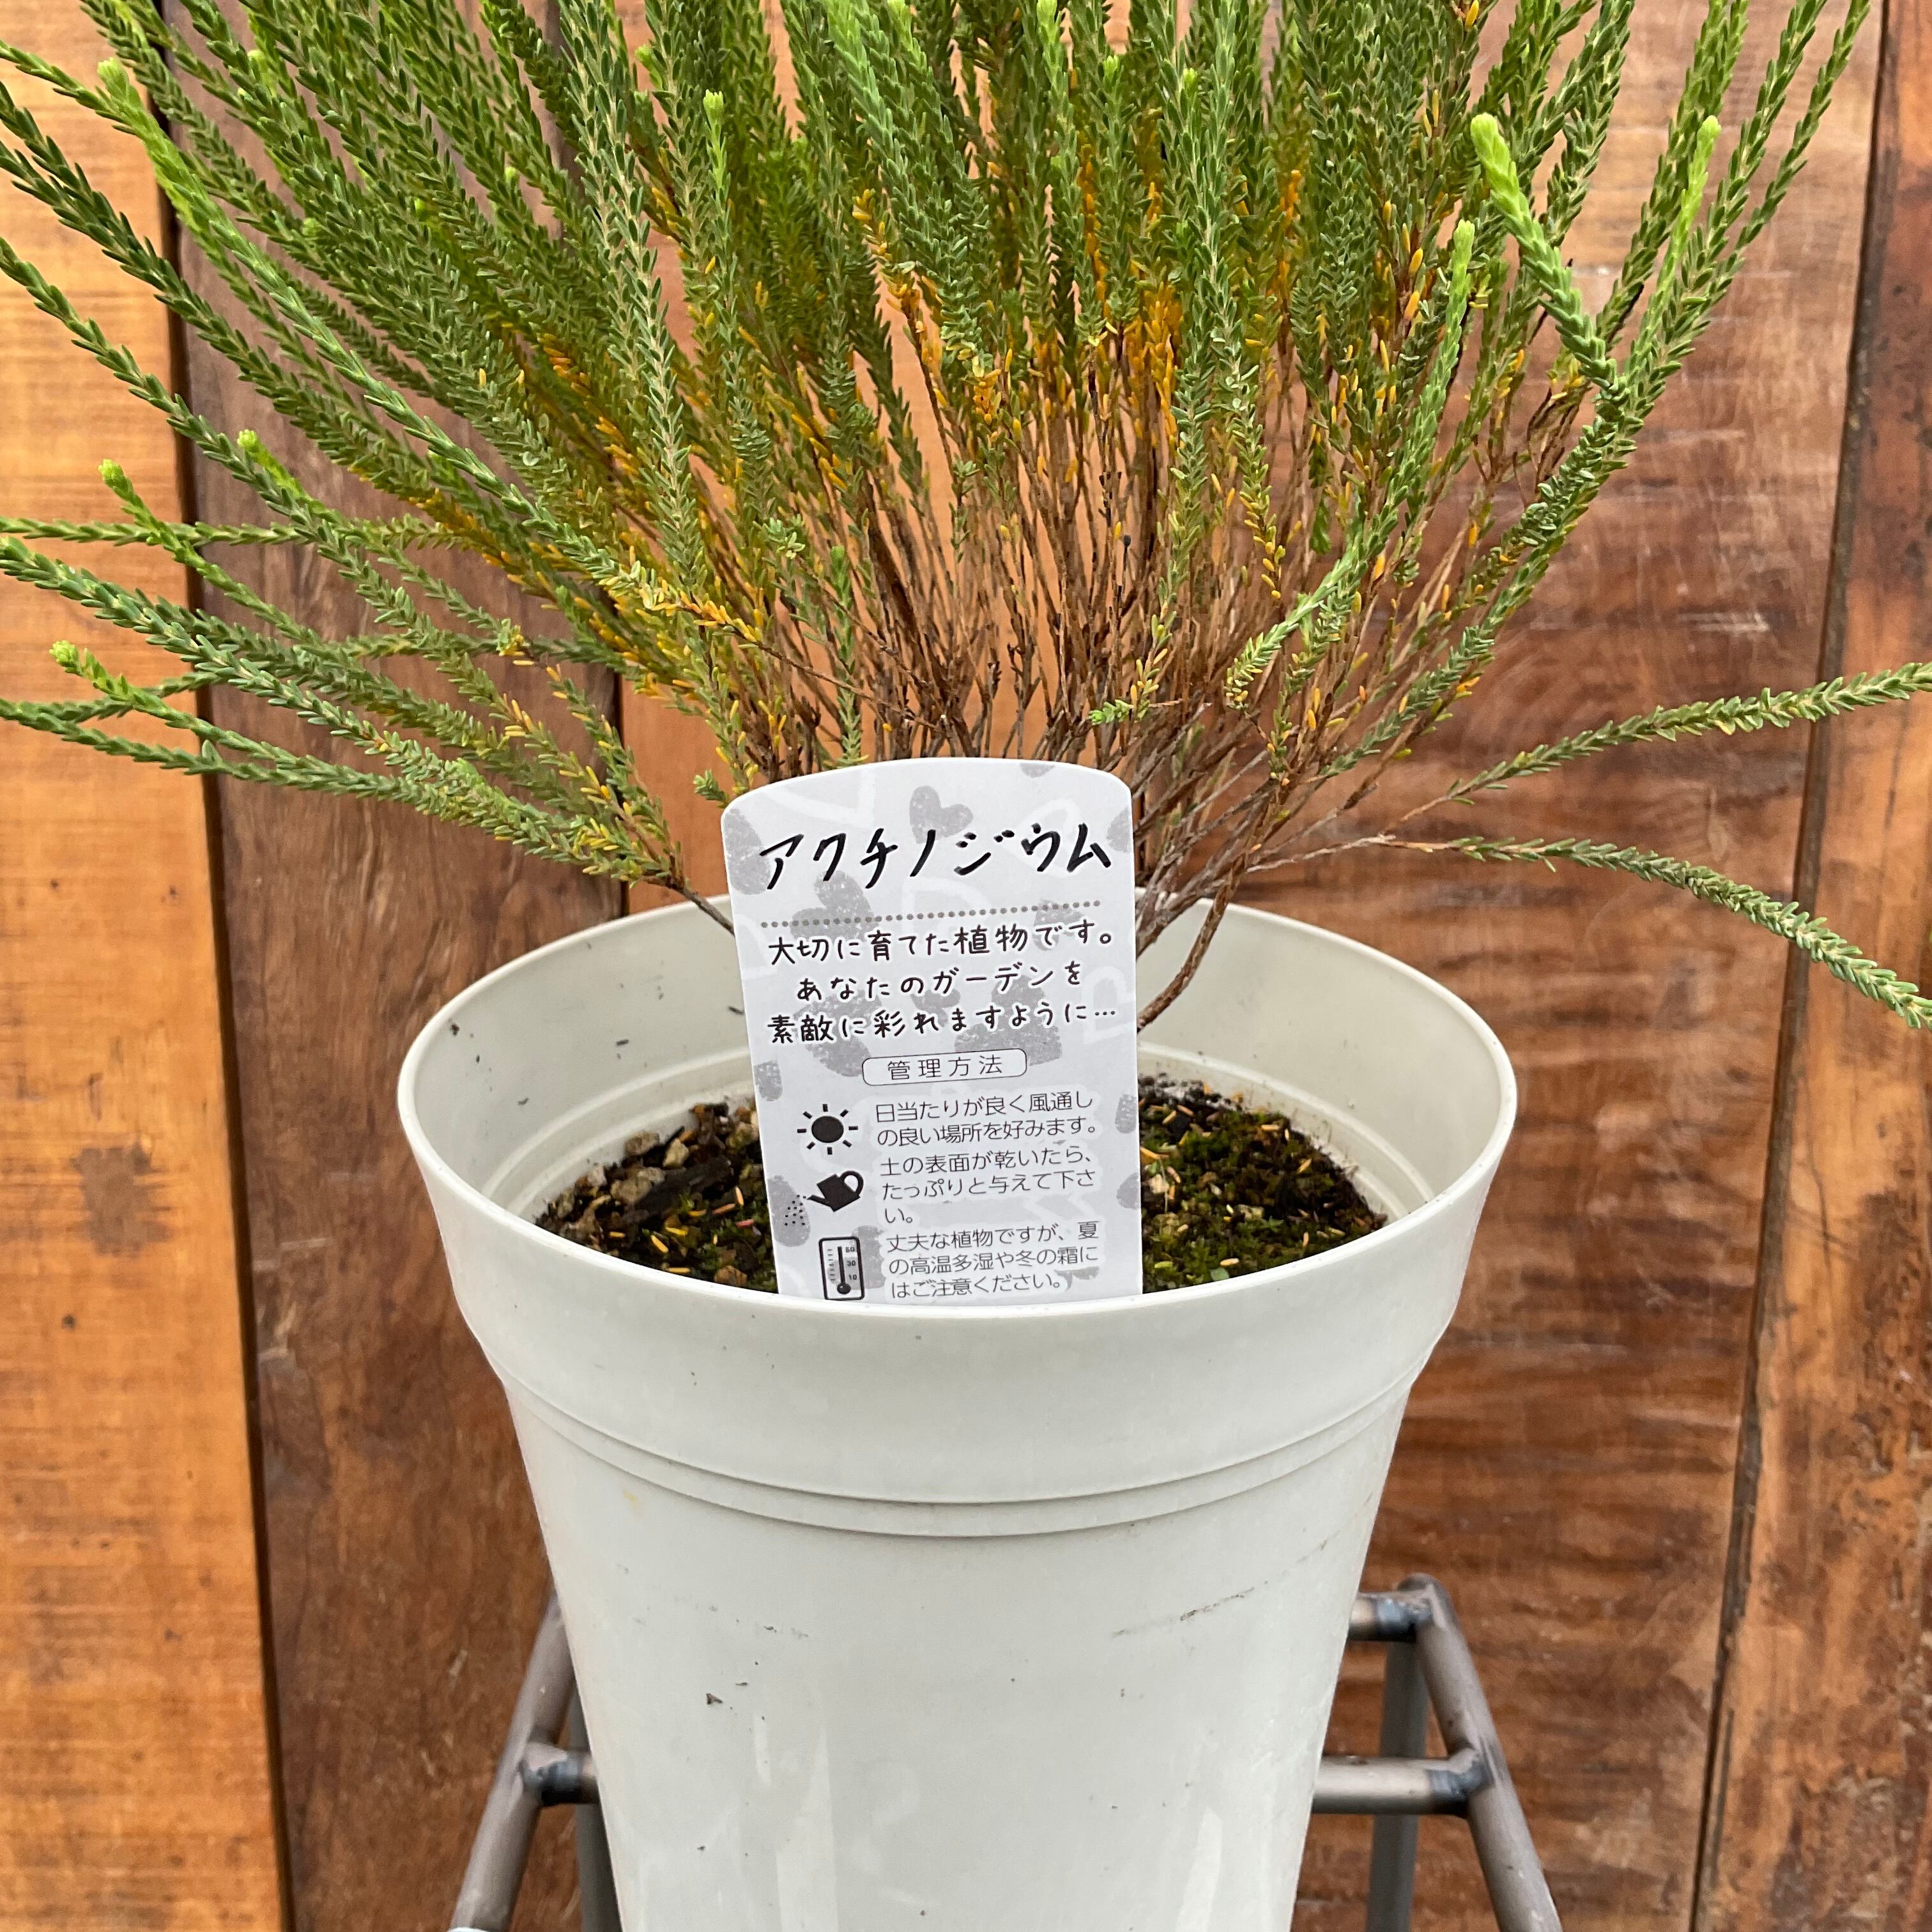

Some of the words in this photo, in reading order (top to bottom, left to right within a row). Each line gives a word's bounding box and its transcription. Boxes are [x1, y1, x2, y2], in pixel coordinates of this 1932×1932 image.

[759, 822, 1112, 889] アクチノジウム
[768, 919, 1112, 966] 大切に育てた植物です。
[797, 961, 1082, 1001] あなたのガーデンを
[887, 1054, 1002, 1081] 管理方法
[877, 1090, 1093, 1123] 日当たりが良く風通し
[878, 1117, 1096, 1146] の良い場所を好みます。
[881, 1145, 1092, 1176] 土の表面が乾いたら、
[882, 1169, 1096, 1200] たっぷりと与えて下さ
[884, 1207, 914, 1224] い。
[886, 1221, 1099, 1253] 丈夫な植物ですが、夏
[889, 1246, 1099, 1275] の高温多湿や冬の霜に
[892, 1273, 1062, 1298] はご注意ください。
